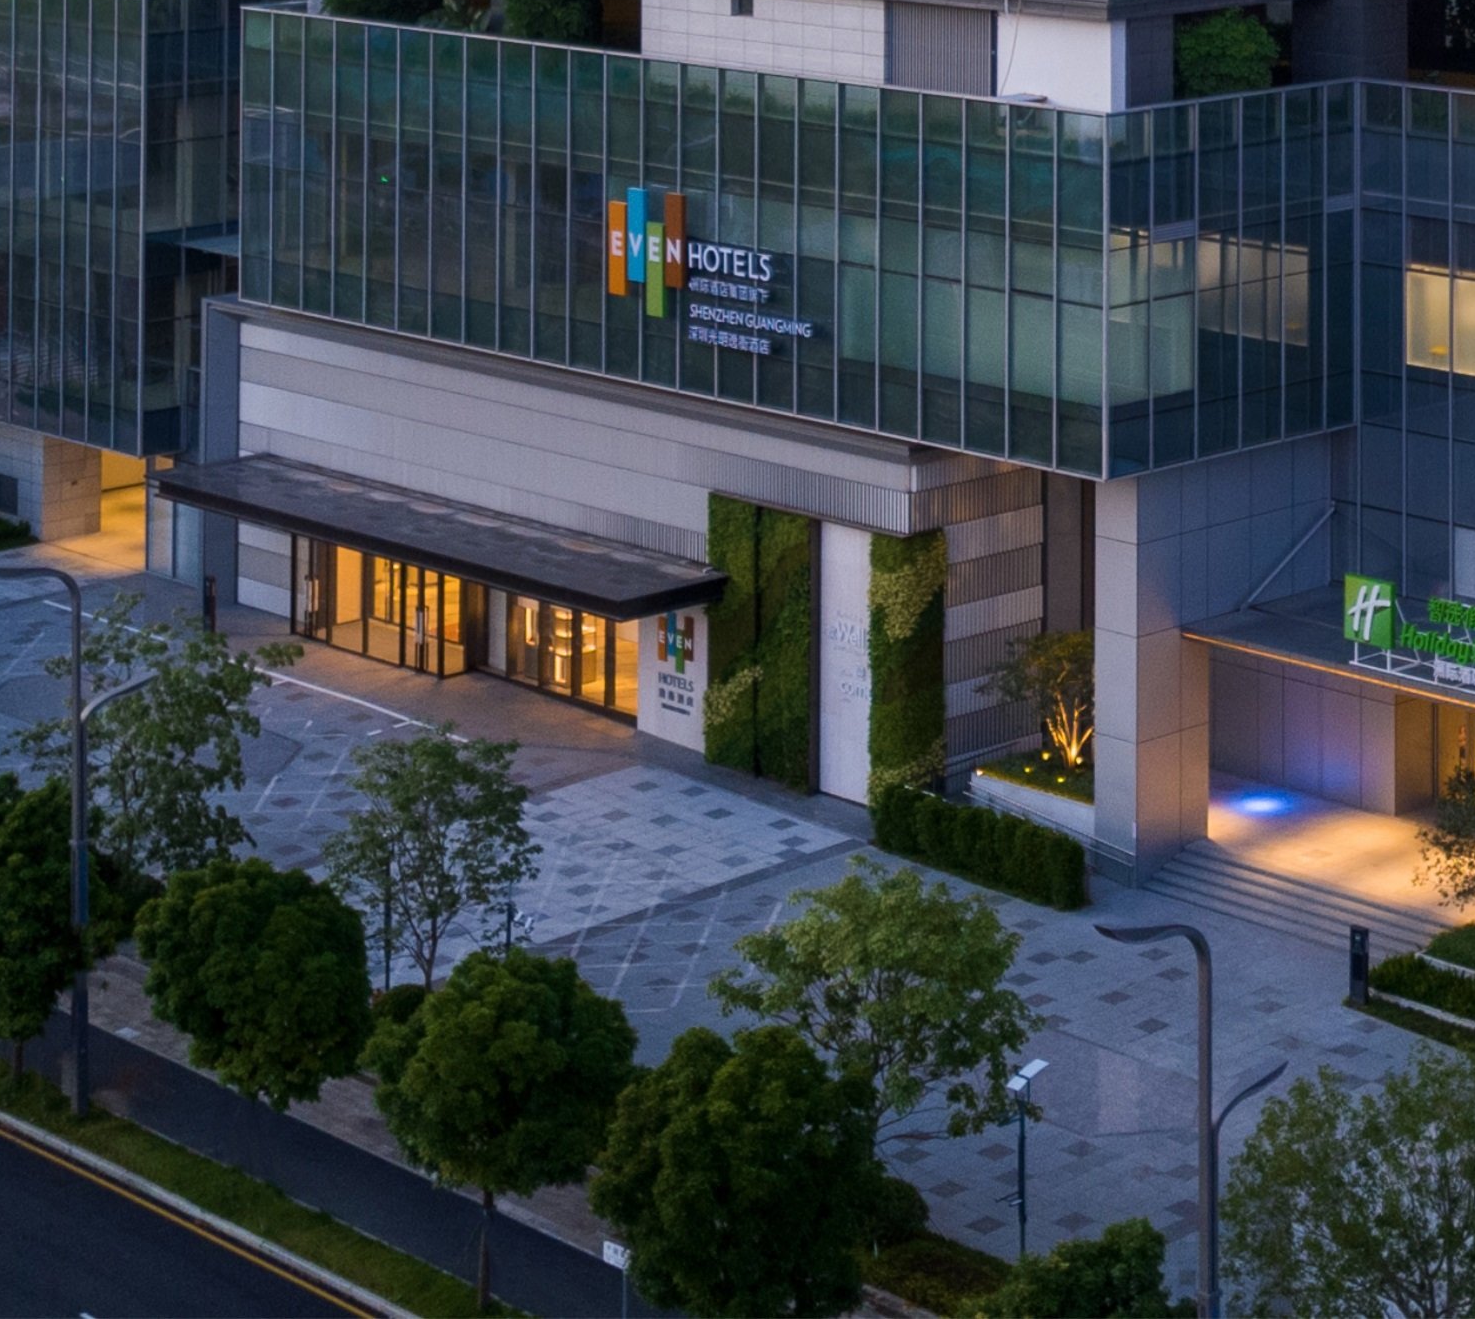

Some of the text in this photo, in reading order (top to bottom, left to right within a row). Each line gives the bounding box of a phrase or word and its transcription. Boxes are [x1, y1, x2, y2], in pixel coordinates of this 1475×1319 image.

[611, 230, 772, 282] EVEN HOTELS
[689, 303, 813, 338] SHENZHEN GUANGMING
[658, 629, 693, 652] EVEN
[1400, 622, 1474, 666] Holiday
[658, 671, 694, 693] HOTELS
